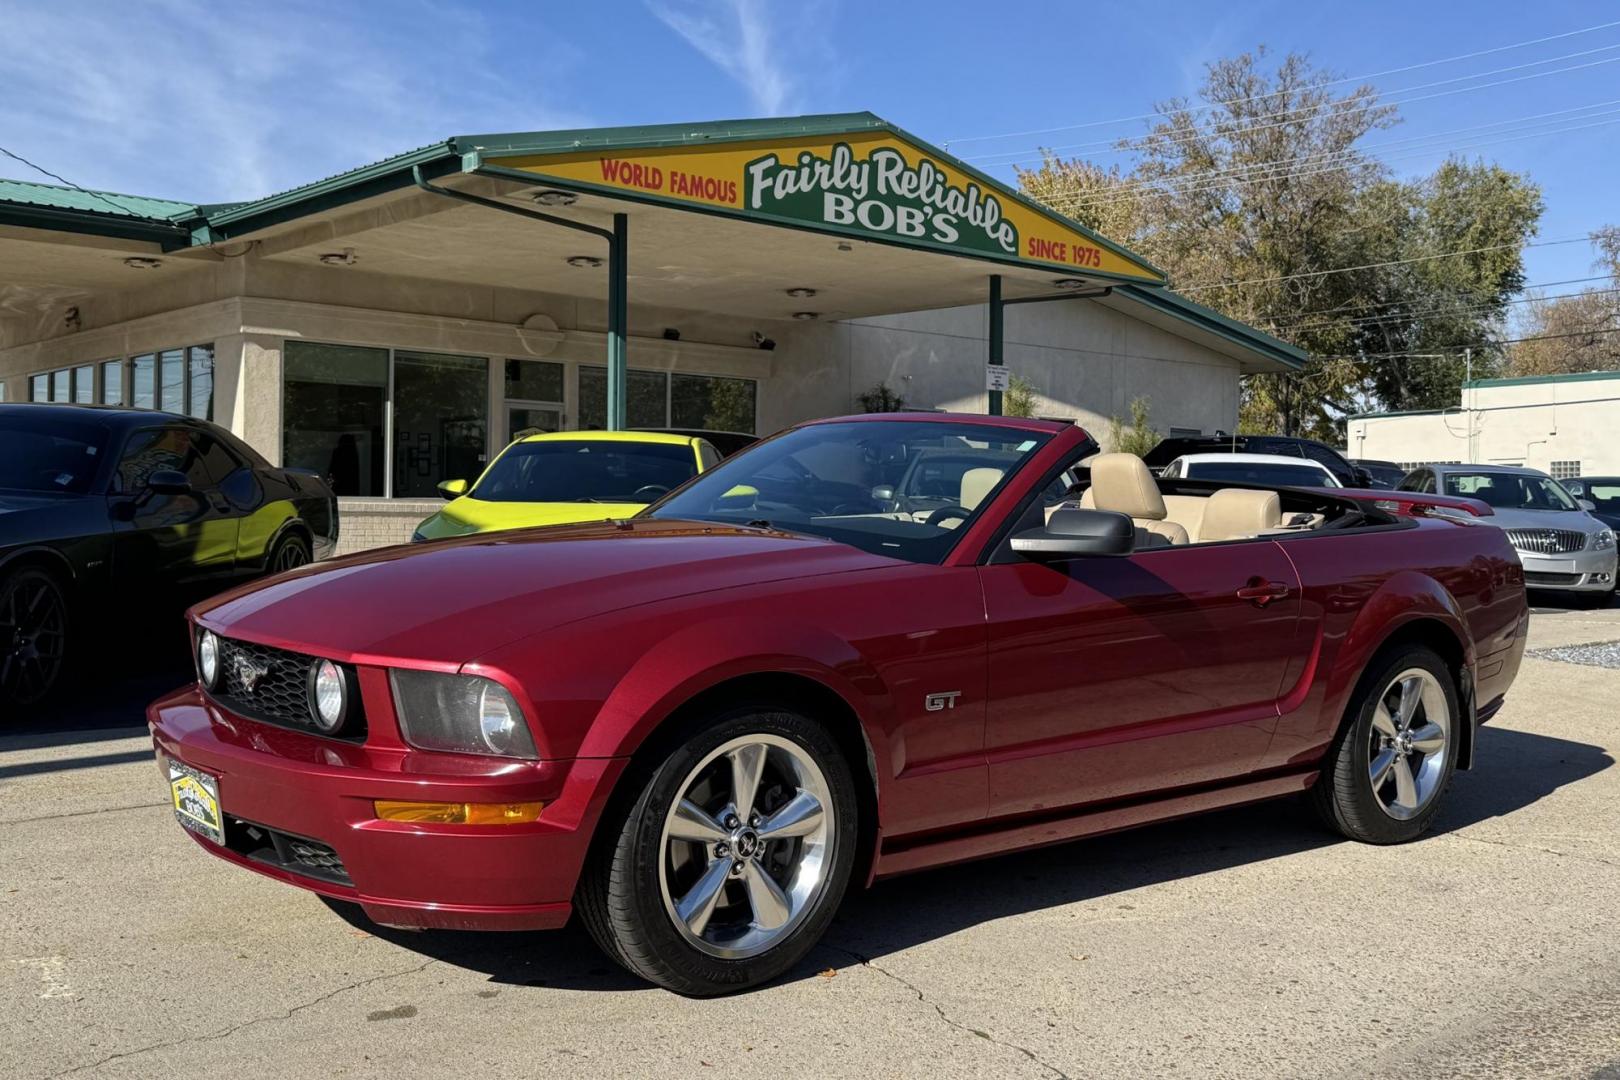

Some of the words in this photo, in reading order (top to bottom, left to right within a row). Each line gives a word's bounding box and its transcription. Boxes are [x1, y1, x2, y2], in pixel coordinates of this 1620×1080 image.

[600, 158, 663, 190] WORLD
[670, 170, 737, 204] FAMOUS
[749, 145, 870, 209] Fairly
[873, 150, 1016, 253] Reliable
[823, 192, 960, 244] BOB'S
[1028, 236, 1067, 262] SINCE
[1071, 244, 1102, 268] 1975
[925, 690, 962, 711] GT
